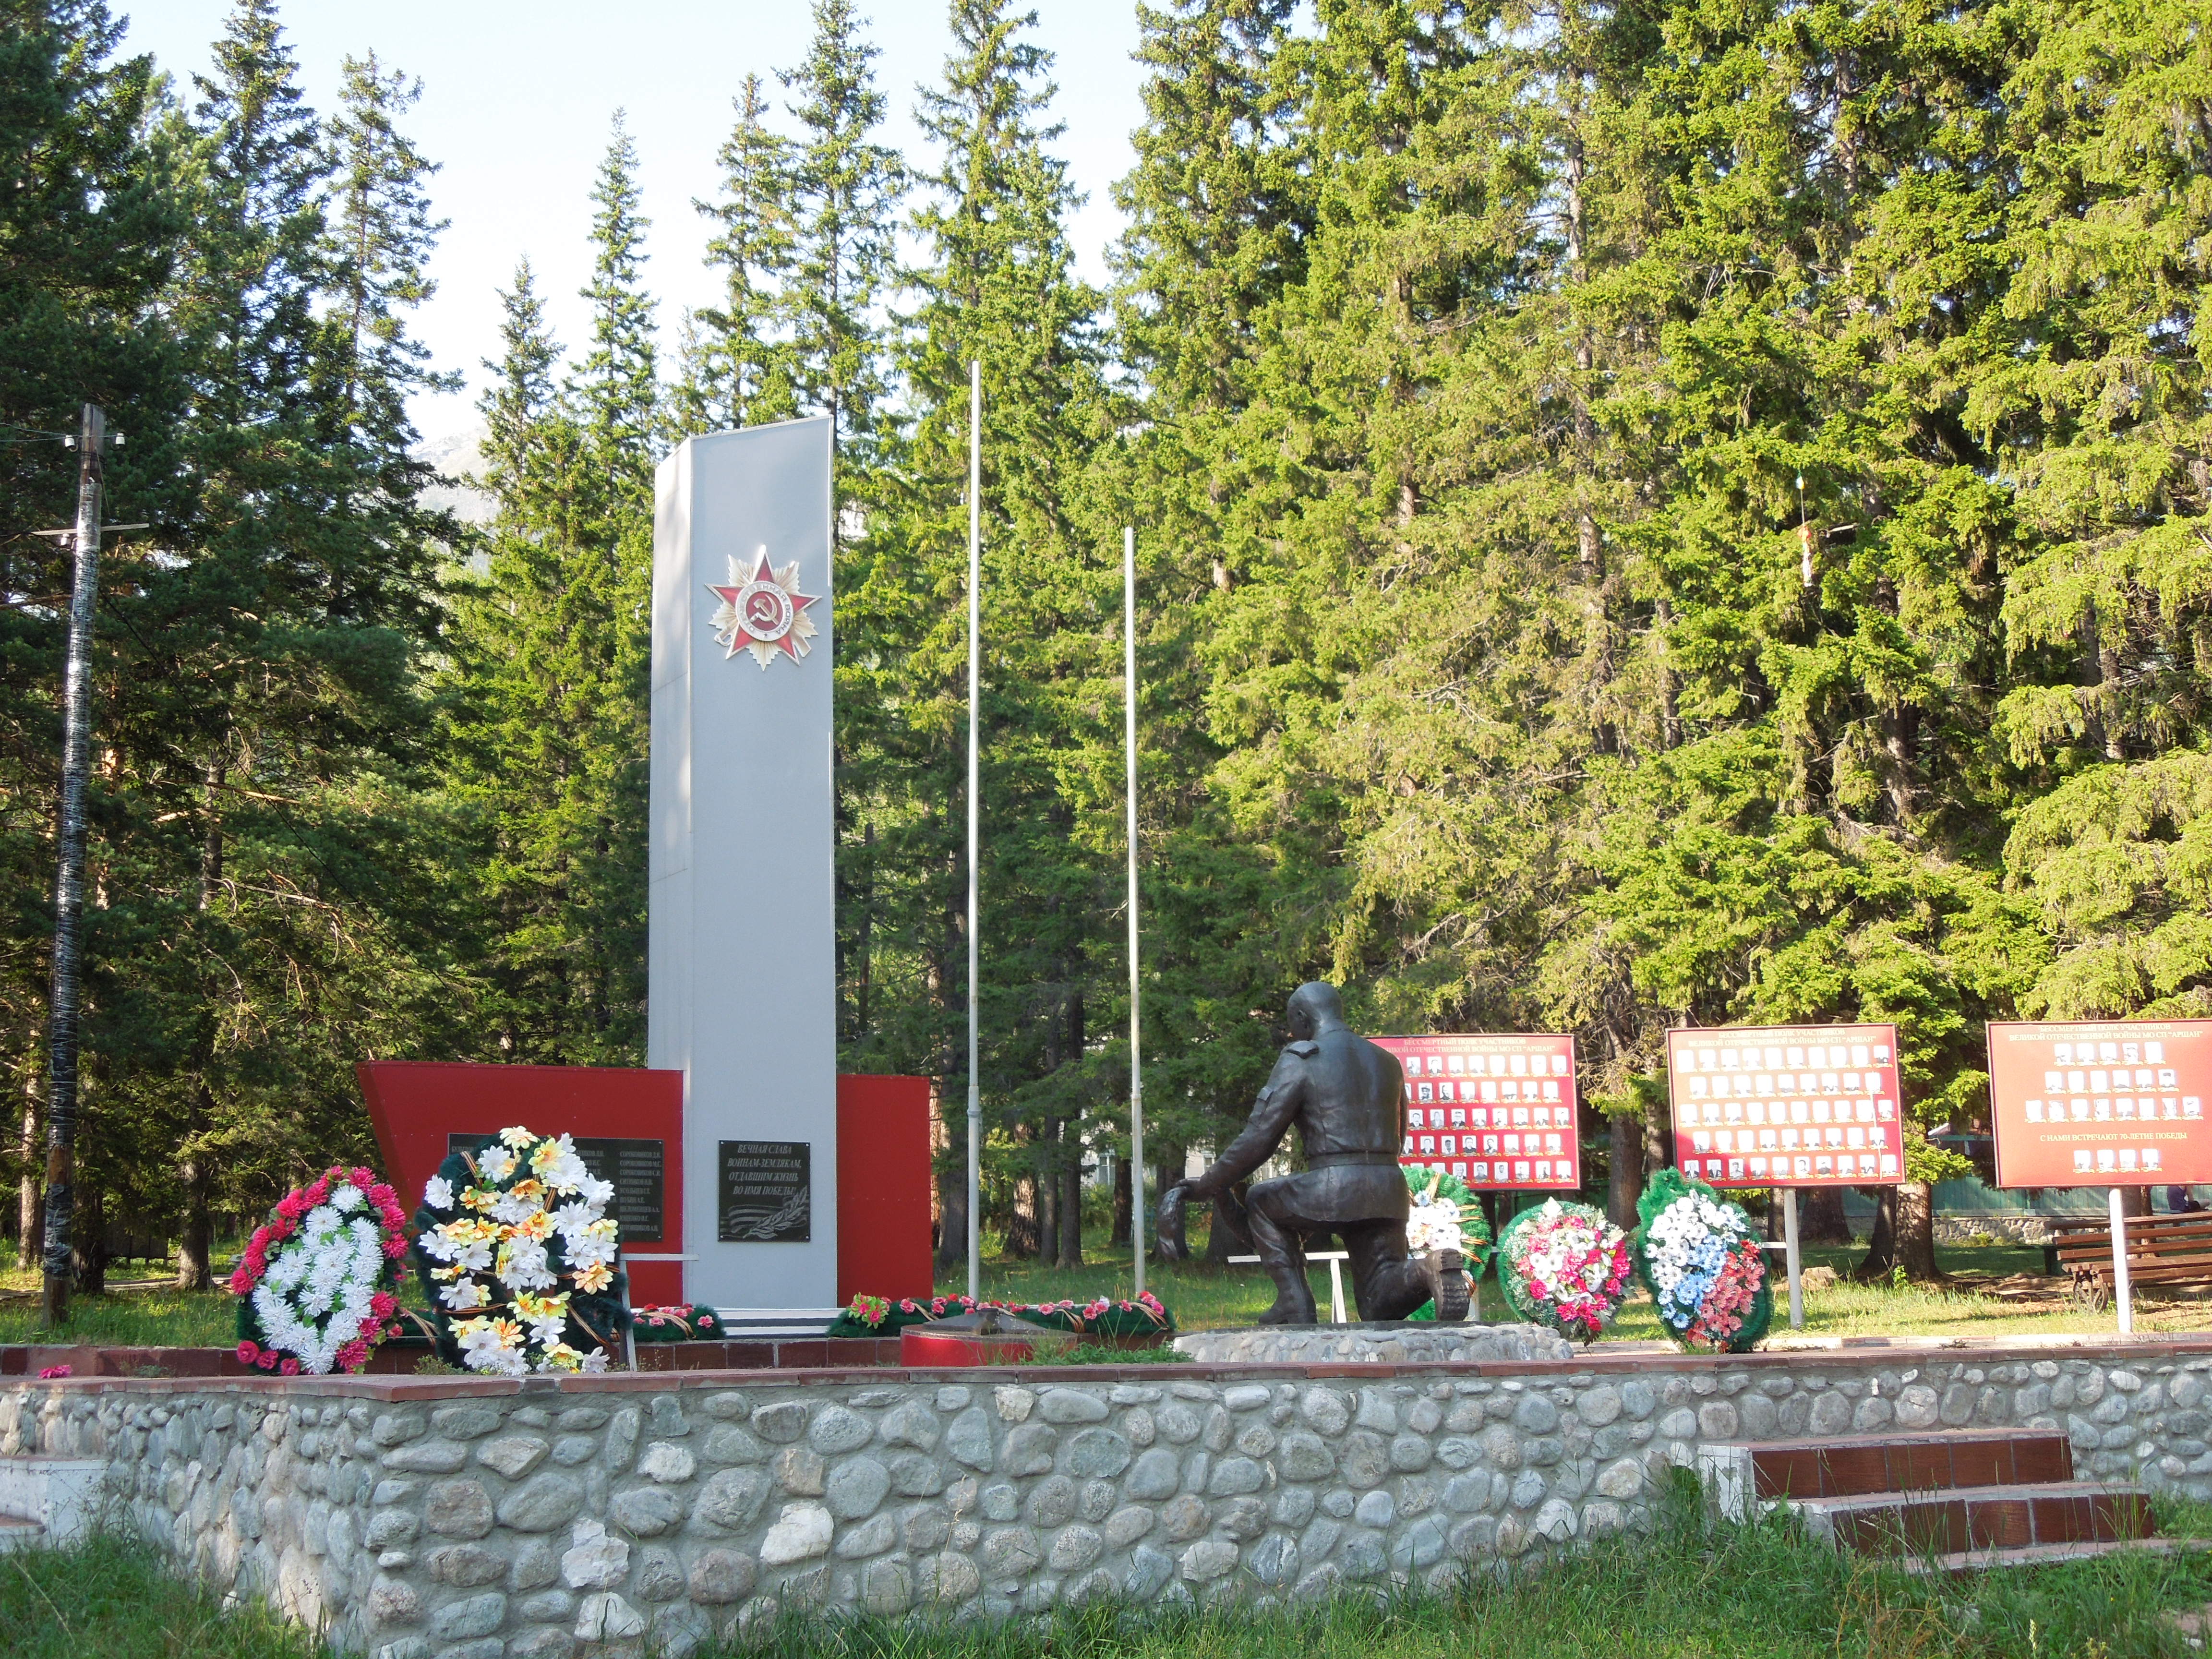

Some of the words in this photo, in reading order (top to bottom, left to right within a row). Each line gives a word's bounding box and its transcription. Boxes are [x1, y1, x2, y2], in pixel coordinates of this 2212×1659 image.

[1789, 1036, 1816, 1045] ВОЙНЫ
[2009, 1033, 2045, 1041] ВЕЛИКОЙ
[2046, 1031, 2112, 1040] ОТЕЧЕСТВЕННОЙ
[738, 1144, 767, 1153] ВЕЧНАЯ
[768, 1145, 792, 1154] СЛАВА
[729, 1172, 773, 1181] ОТДАВШИМ
[773, 1172, 799, 1181] ЖИЗНЬ
[733, 1186, 743, 1194] ВО
[744, 1186, 762, 1195] ИМЯ
